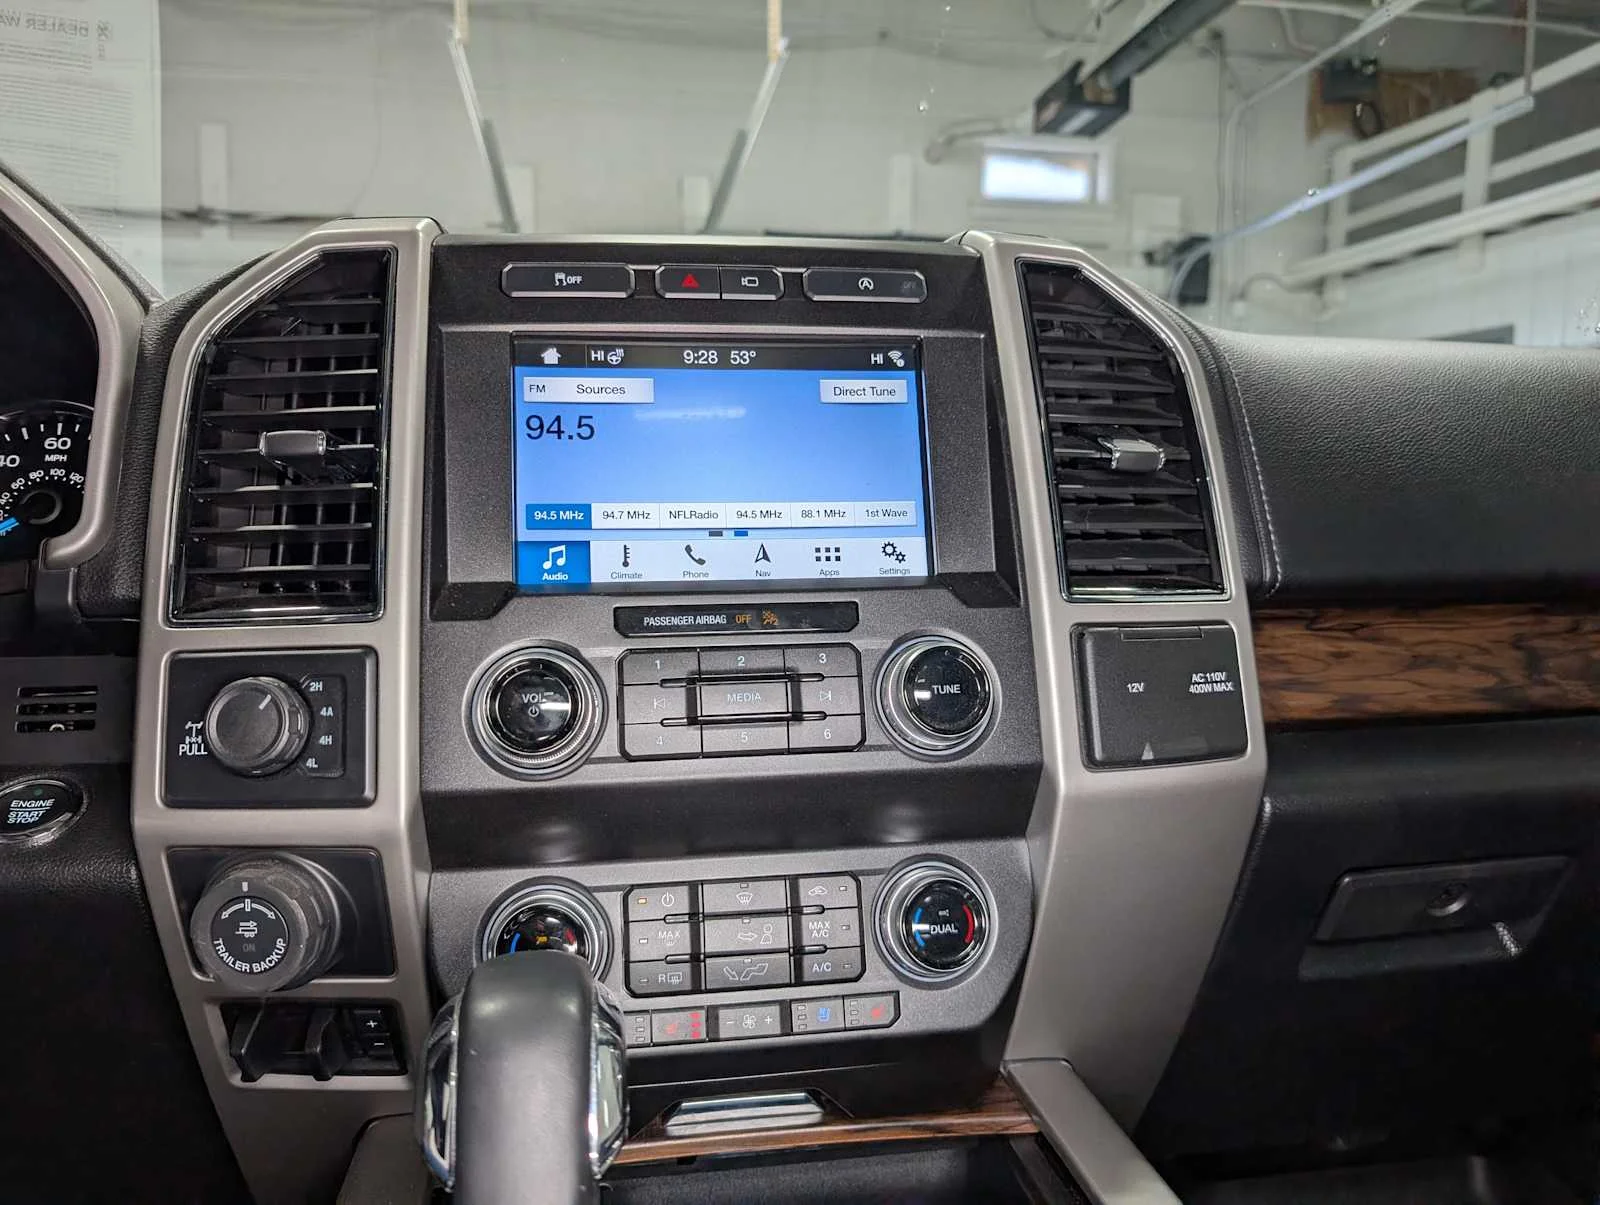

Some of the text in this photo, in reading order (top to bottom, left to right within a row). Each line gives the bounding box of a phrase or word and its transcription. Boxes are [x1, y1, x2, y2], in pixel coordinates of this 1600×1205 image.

[567, 276, 582, 284] OFF
[591, 350, 605, 362] HI
[683, 350, 757, 365] 9:28 53°
[871, 353, 884, 365] HI
[529, 384, 626, 396] FM Sources
[833, 386, 896, 397] Direct Tune
[525, 414, 595, 441] 94.5
[44, 437, 71, 450] 60
[44, 454, 68, 462] MPH
[28, 470, 44, 480] 80
[50, 468, 66, 477] 100
[70, 472, 84, 484] 120
[11, 478, 25, 490] 60
[534, 510, 584, 520] 94.5 MHz
[602, 511, 651, 520] 94.7 MHz
[669, 510, 719, 520] NFLRadio
[736, 510, 782, 519] 94.5 MHz
[801, 510, 847, 518] 88.1 MHz
[865, 509, 908, 518] 1st Wave
[542, 572, 568, 581] Audio
[610, 571, 643, 580] Climate
[682, 570, 710, 578] Phone
[755, 570, 771, 578] Nav
[819, 568, 840, 577] Apps
[879, 568, 910, 576] Settings
[644, 614, 752, 626] PASSENGER AIRBAG OFF
[737, 656, 746, 666] 2
[818, 654, 827, 664] 3
[654, 660, 661, 670] 1
[1192, 672, 1226, 683] AC 110V
[309, 682, 322, 692] 2H
[932, 683, 961, 695] TUNE
[1127, 683, 1145, 694] 12V
[1189, 682, 1234, 694] 400W MAX
[522, 693, 546, 704] VOL
[727, 692, 762, 703] MEDIA
[320, 707, 333, 717] 4A
[741, 732, 748, 742] 5
[824, 729, 832, 740] 6
[318, 735, 332, 746] 4H
[656, 736, 664, 746] 4
[178, 744, 208, 756] PULL
[306, 758, 318, 768] 4L
[10, 798, 56, 808] ENGINE
[8, 810, 46, 818] START
[808, 920, 831, 930] MAX
[930, 923, 958, 934] DUAL
[658, 930, 681, 940] MAX
[812, 929, 829, 938] A/C
[242, 943, 256, 952] ON
[213, 938, 288, 972] TRAILER BACKUP
[812, 962, 832, 972] A/C
[658, 974, 666, 984] R
